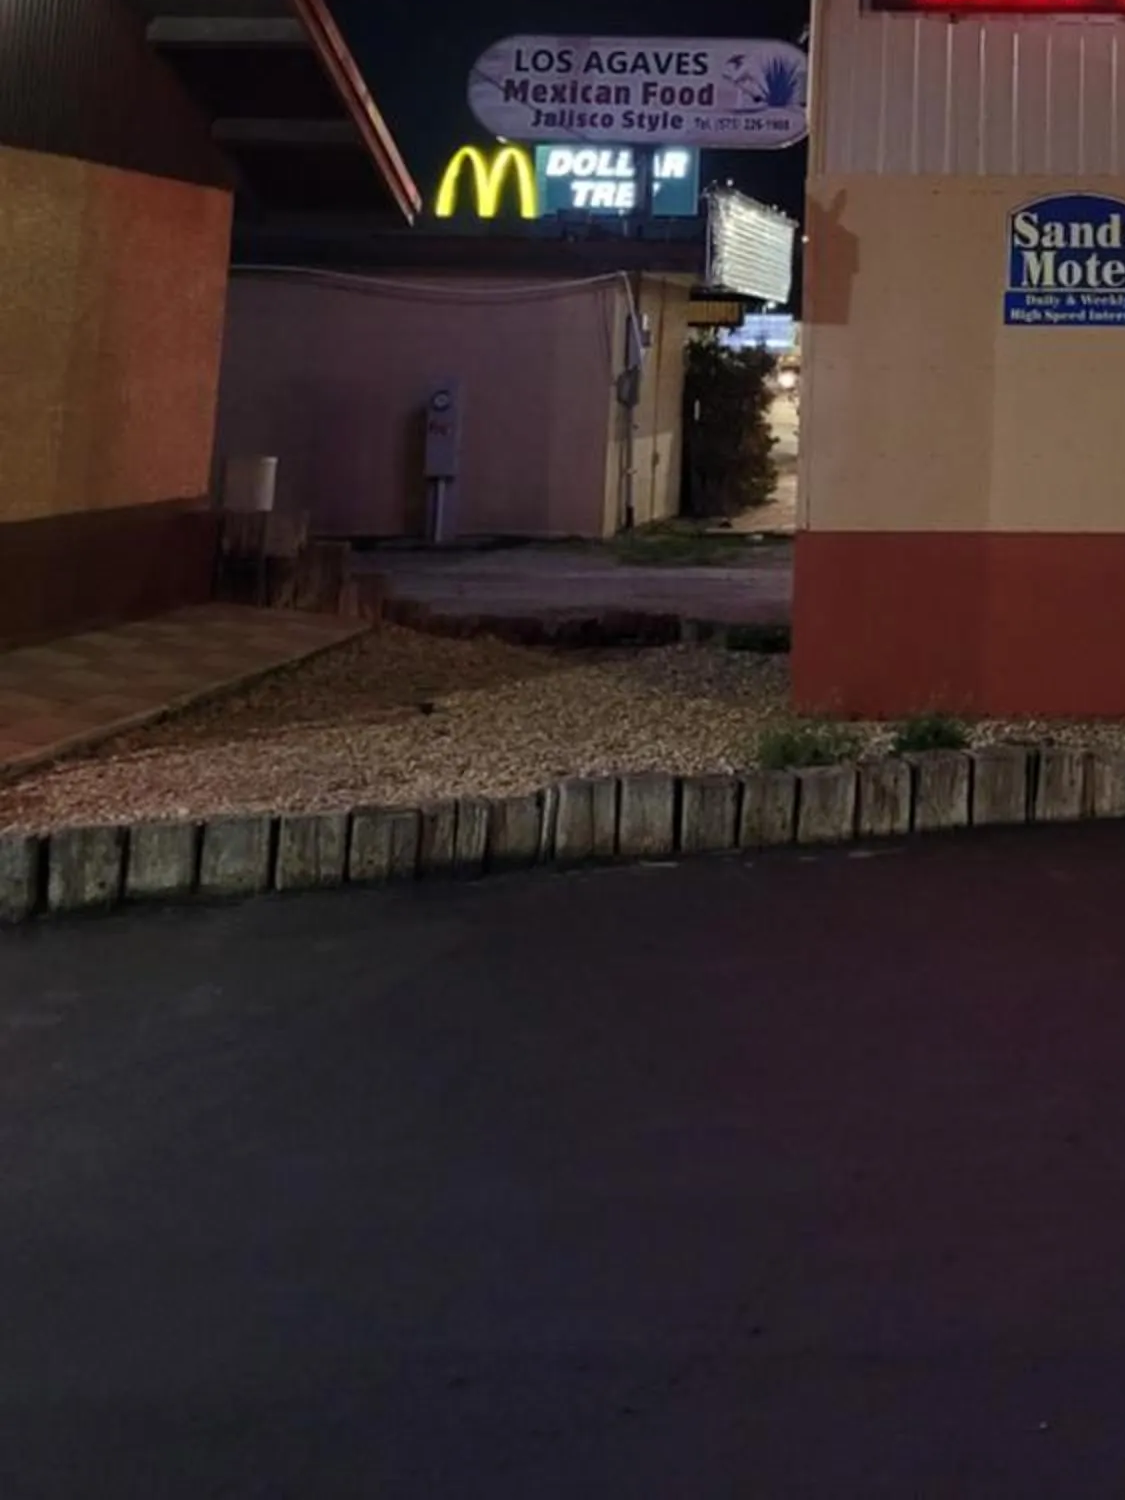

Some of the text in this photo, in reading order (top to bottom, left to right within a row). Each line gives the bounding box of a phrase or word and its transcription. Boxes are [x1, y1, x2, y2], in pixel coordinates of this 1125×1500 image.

[514, 49, 709, 76] LOS AGAVES
[503, 78, 715, 107] Mexican Food
[530, 109, 684, 133] Jalisco Style
[1026, 294, 1060, 308] Daily
[1010, 308, 1042, 323] High
[1044, 309, 1086, 323] Speed
